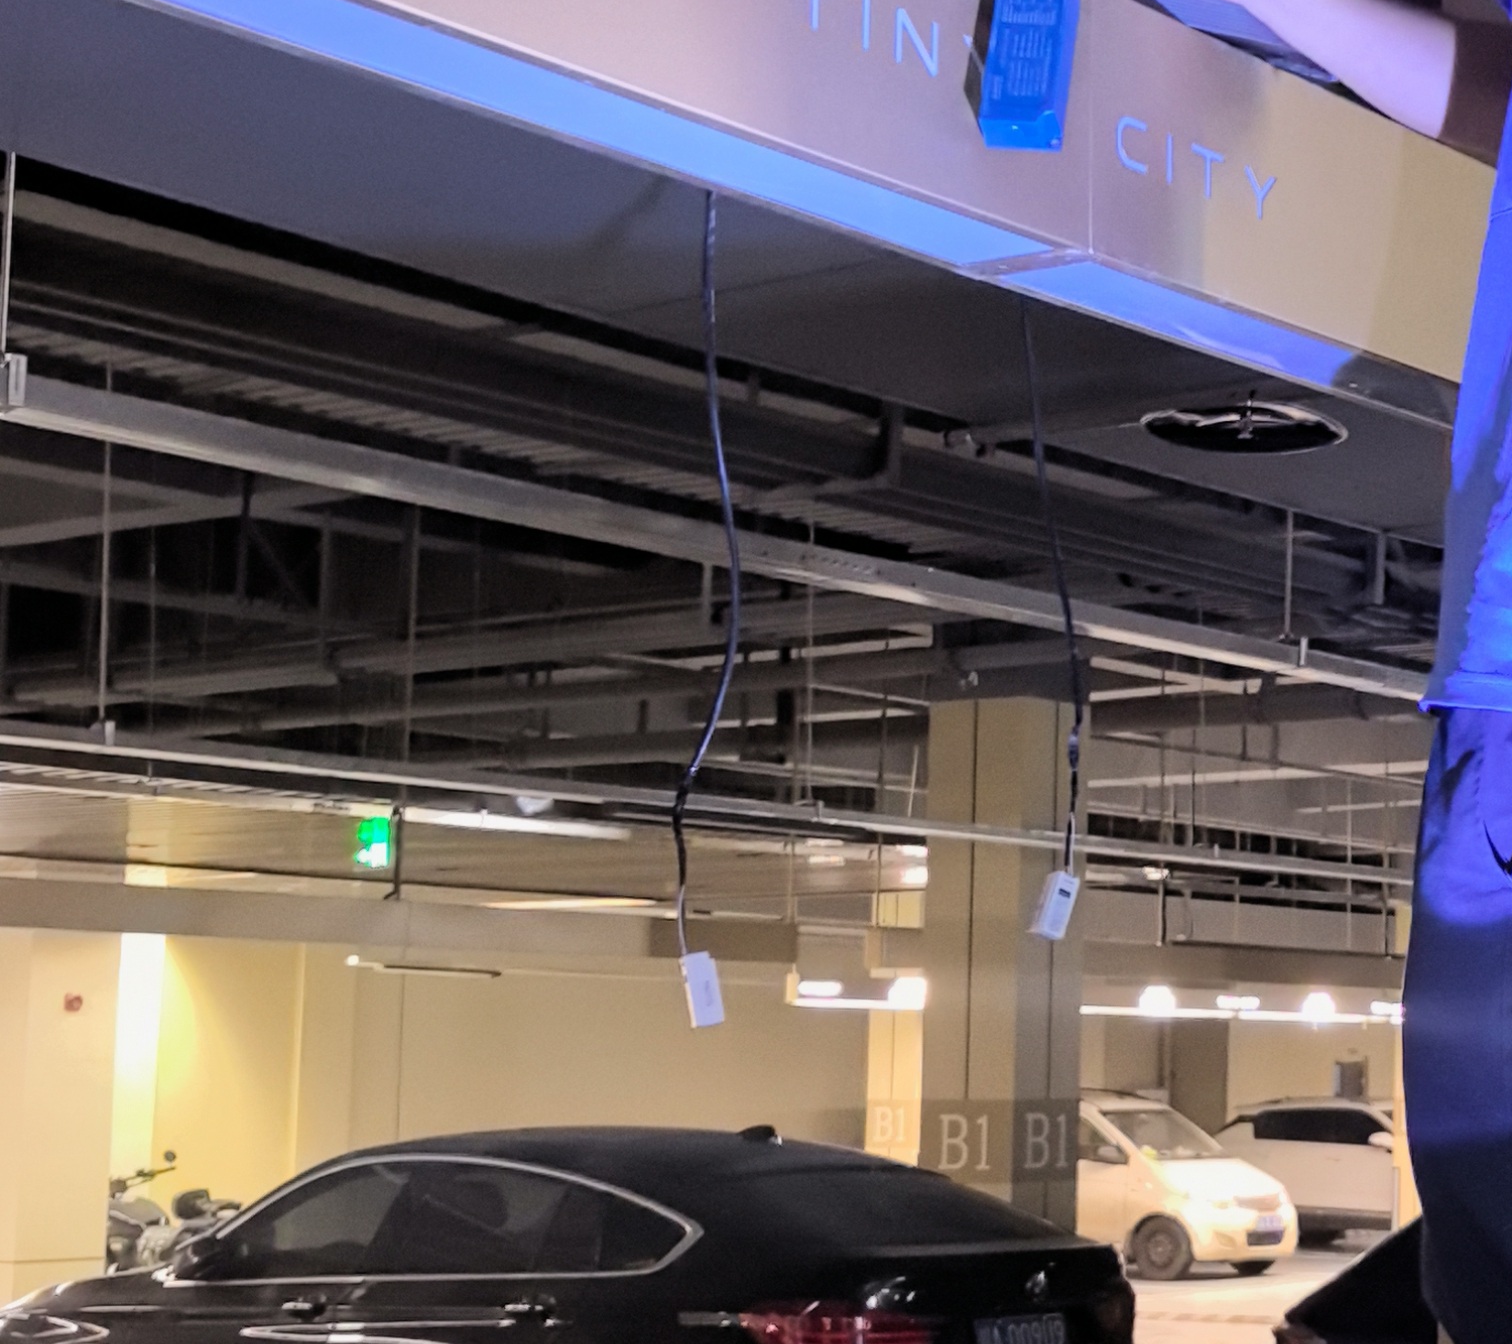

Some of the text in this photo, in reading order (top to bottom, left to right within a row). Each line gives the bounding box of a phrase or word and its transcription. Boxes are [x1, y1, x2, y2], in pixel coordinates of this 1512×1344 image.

[1115, 115, 1277, 220] CITY
[873, 1106, 906, 1143] B1
[938, 1114, 991, 1171] B1
[1024, 1112, 1069, 1169] B1
